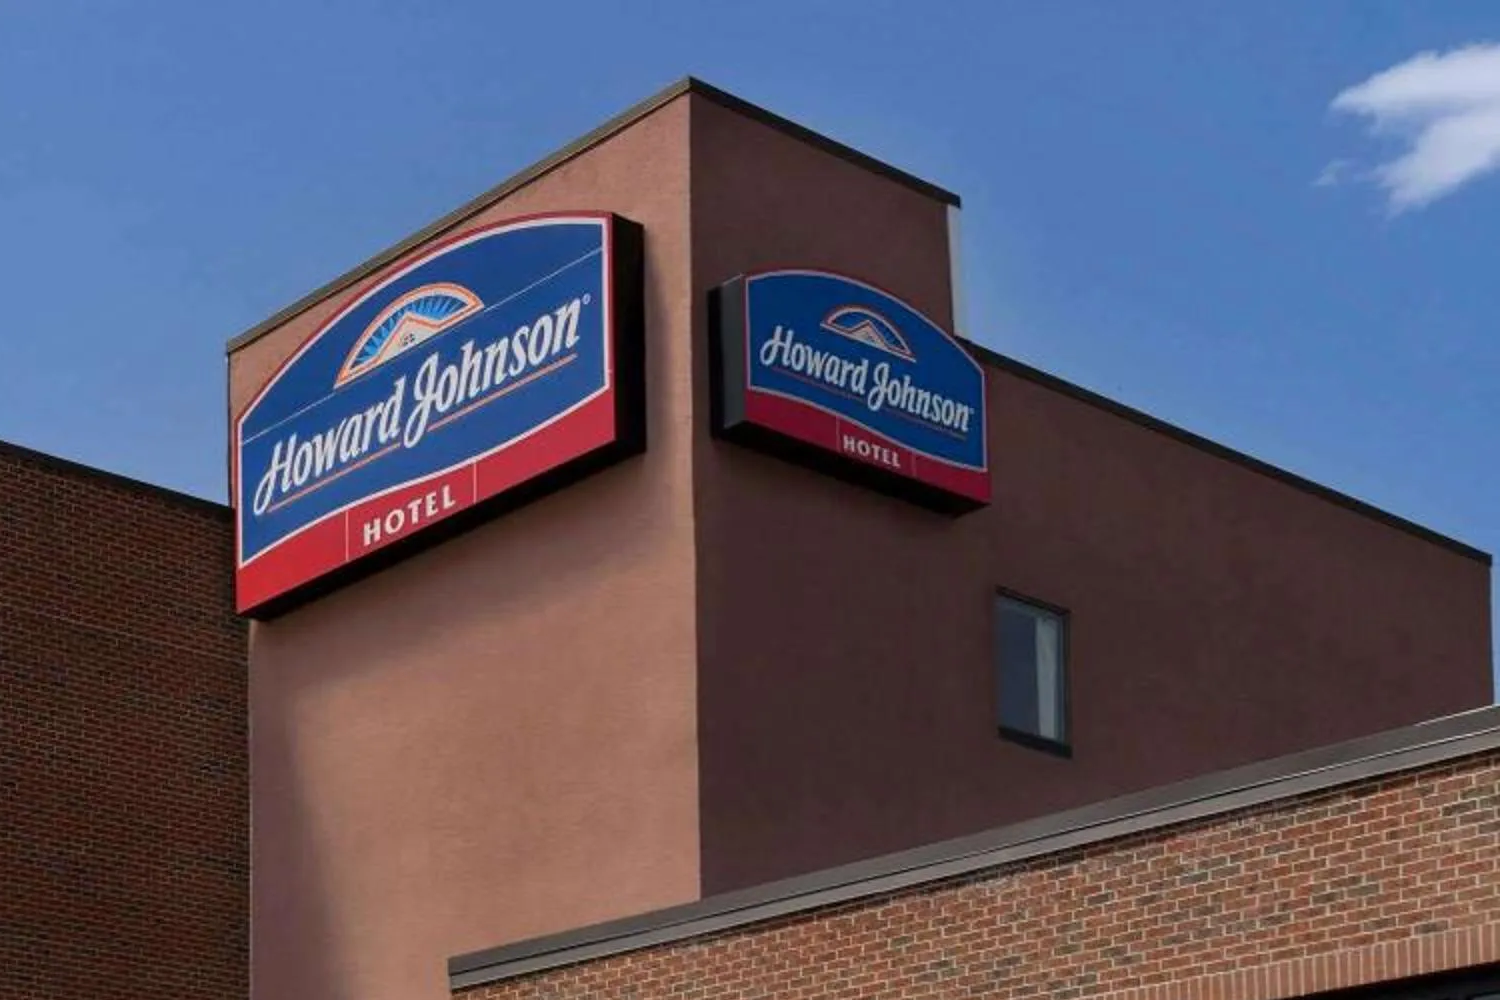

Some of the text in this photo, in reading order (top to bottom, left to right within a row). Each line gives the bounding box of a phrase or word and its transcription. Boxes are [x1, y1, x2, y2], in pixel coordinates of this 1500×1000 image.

[253, 298, 581, 516] Howard Johnson
[759, 324, 970, 433] Howard Johnson
[842, 434, 901, 468] HOTEL
[362, 484, 456, 547] HOTEL
